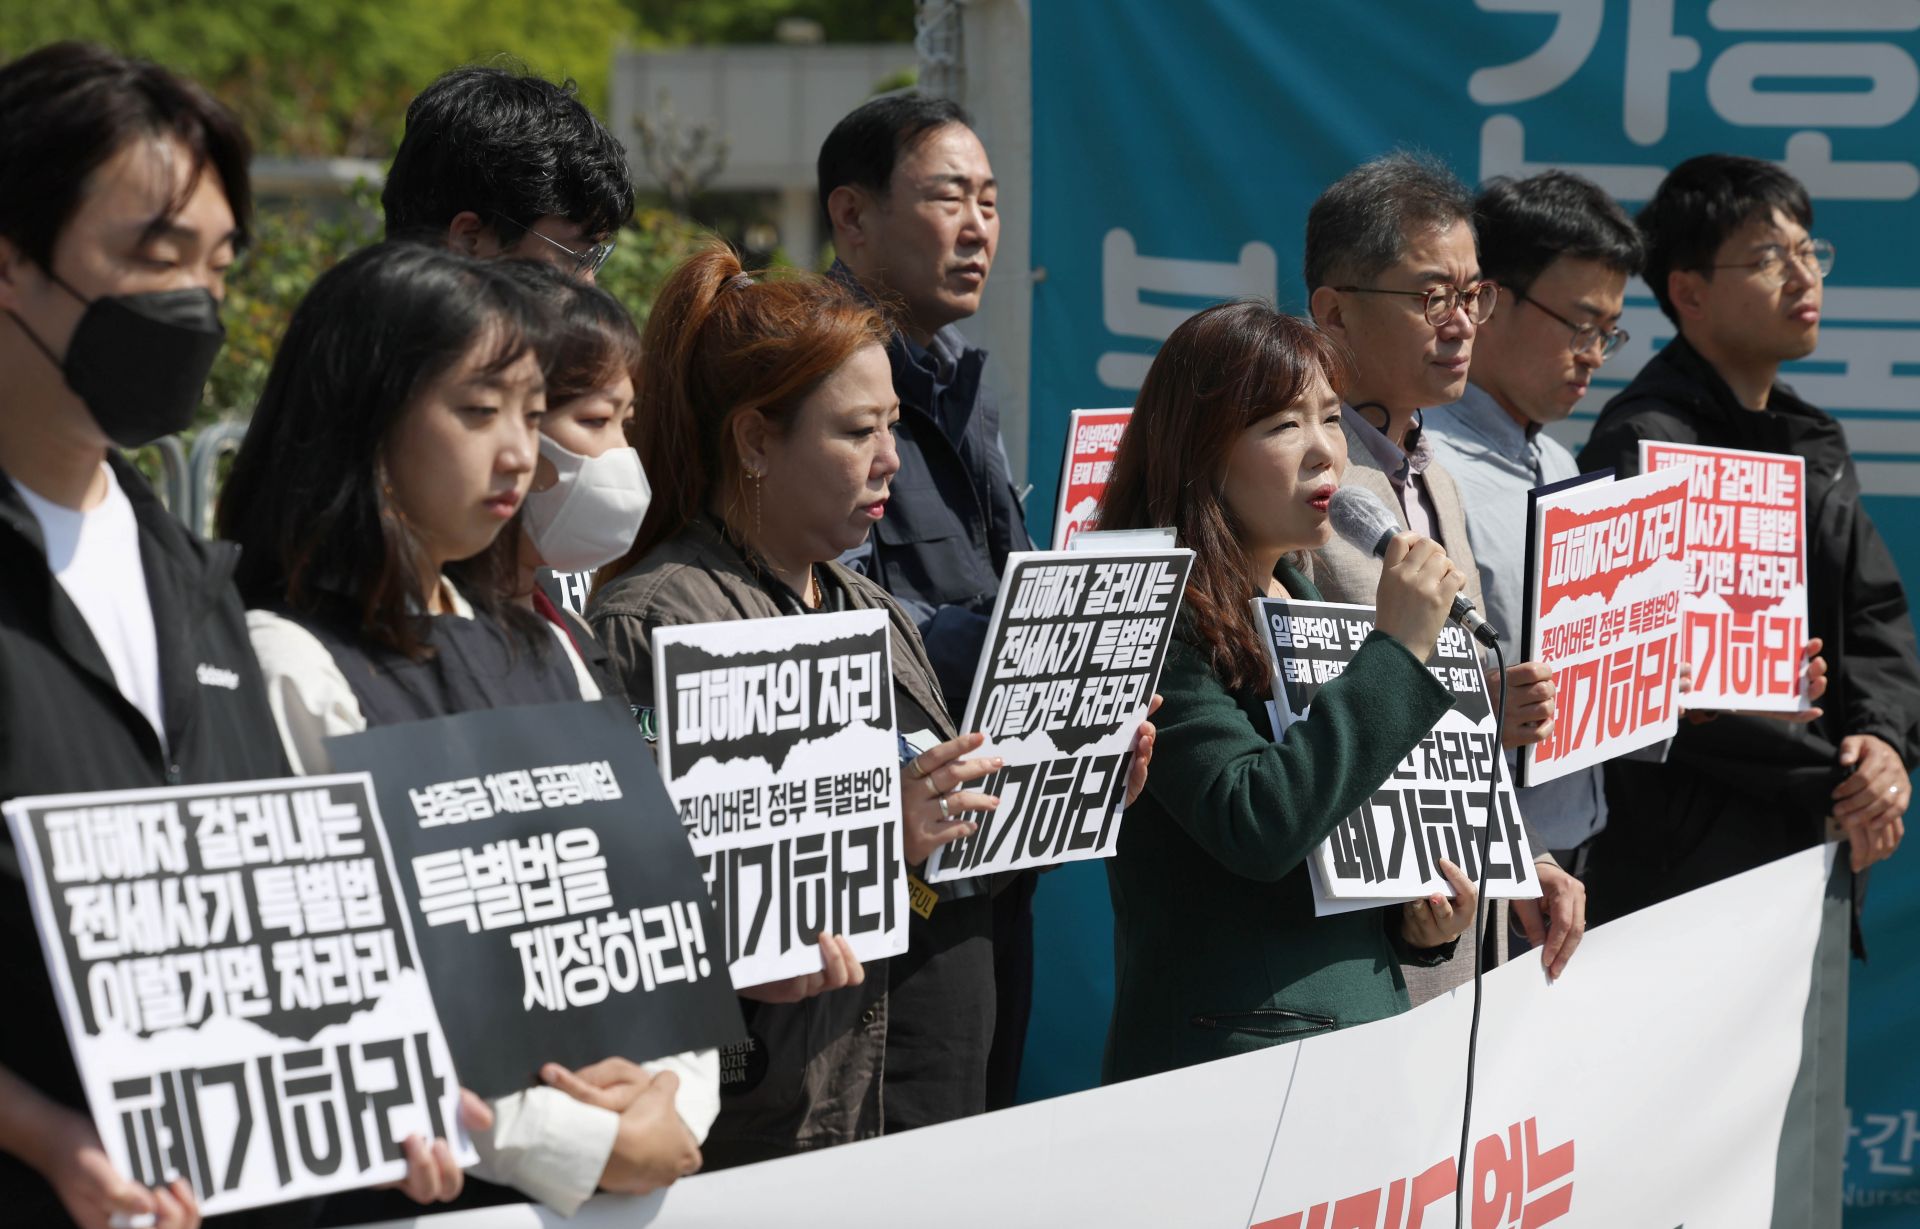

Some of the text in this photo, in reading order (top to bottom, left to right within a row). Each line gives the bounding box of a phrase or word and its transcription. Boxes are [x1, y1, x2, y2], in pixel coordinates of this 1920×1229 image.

[1720, 458, 1796, 506] 걸러내는
[1548, 499, 1684, 587] 피해자의 자리
[1687, 502, 1797, 553] 사기 특별법
[1009, 562, 1177, 620] 피해자 걸러내는
[1738, 553, 1797, 599] 차라리
[994, 617, 1166, 679] 전세사기 특별법
[1271, 614, 1341, 650] 일방적인
[1541, 590, 1680, 663] 찢어버린 정부 특별법안
[1682, 610, 1803, 698] 기하라
[676, 659, 810, 745] 피해자의
[817, 651, 881, 726] 자리
[980, 673, 1150, 737] 이럴거면 차라리
[1283, 657, 1313, 684] 문제
[1449, 667, 1480, 692] 없다!
[1419, 731, 1502, 783] 차라리
[409, 760, 623, 829] 보증금 채권 공공매입
[768, 780, 807, 827] 정부
[814, 767, 891, 819] 특별법안
[44, 789, 366, 883] 피해자 걸러내는
[65, 858, 386, 960] 전세사기 특별법
[411, 827, 614, 934] 특별법을
[88, 929, 399, 1033] 이럴거면 차라리
[510, 900, 711, 1011] 제정하라!
[113, 1032, 446, 1200] 폐기하라
